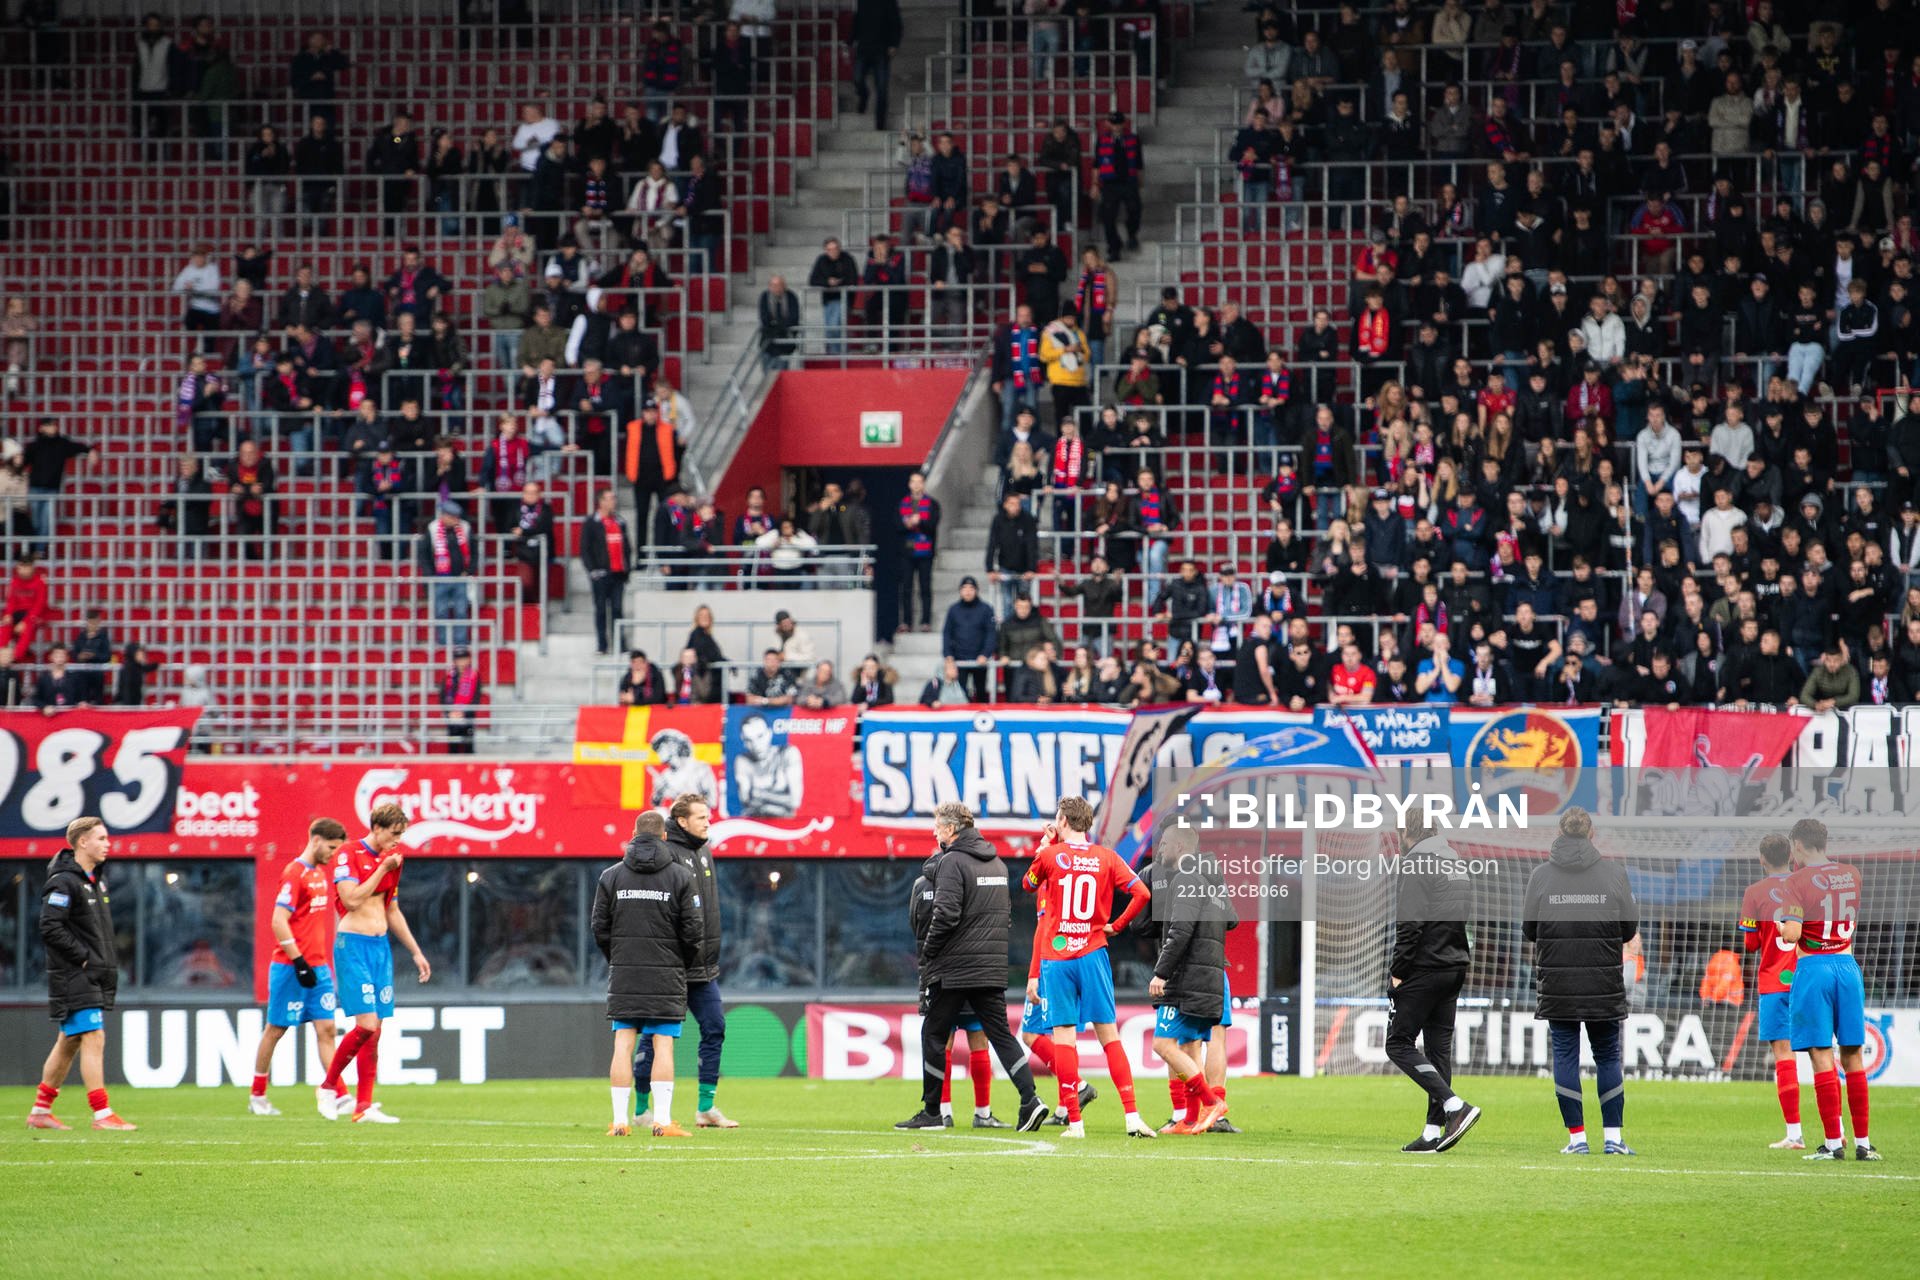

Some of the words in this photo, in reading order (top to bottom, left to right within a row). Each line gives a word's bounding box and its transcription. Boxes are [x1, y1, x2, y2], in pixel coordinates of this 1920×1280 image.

[176, 783, 260, 818] beat
[176, 819, 259, 836] diabetes
[1073, 855, 1100, 866] beat
[616, 889, 663, 901] HELSINGBORGS
[1058, 874, 1097, 920] 10
[1549, 894, 1599, 905] HELSINGBORGS
[1600, 894, 1607, 904] IF
[1820, 891, 1856, 940] 15
[1058, 921, 1091, 933] JÖNSSON
[1163, 1004, 1175, 1020] 16
